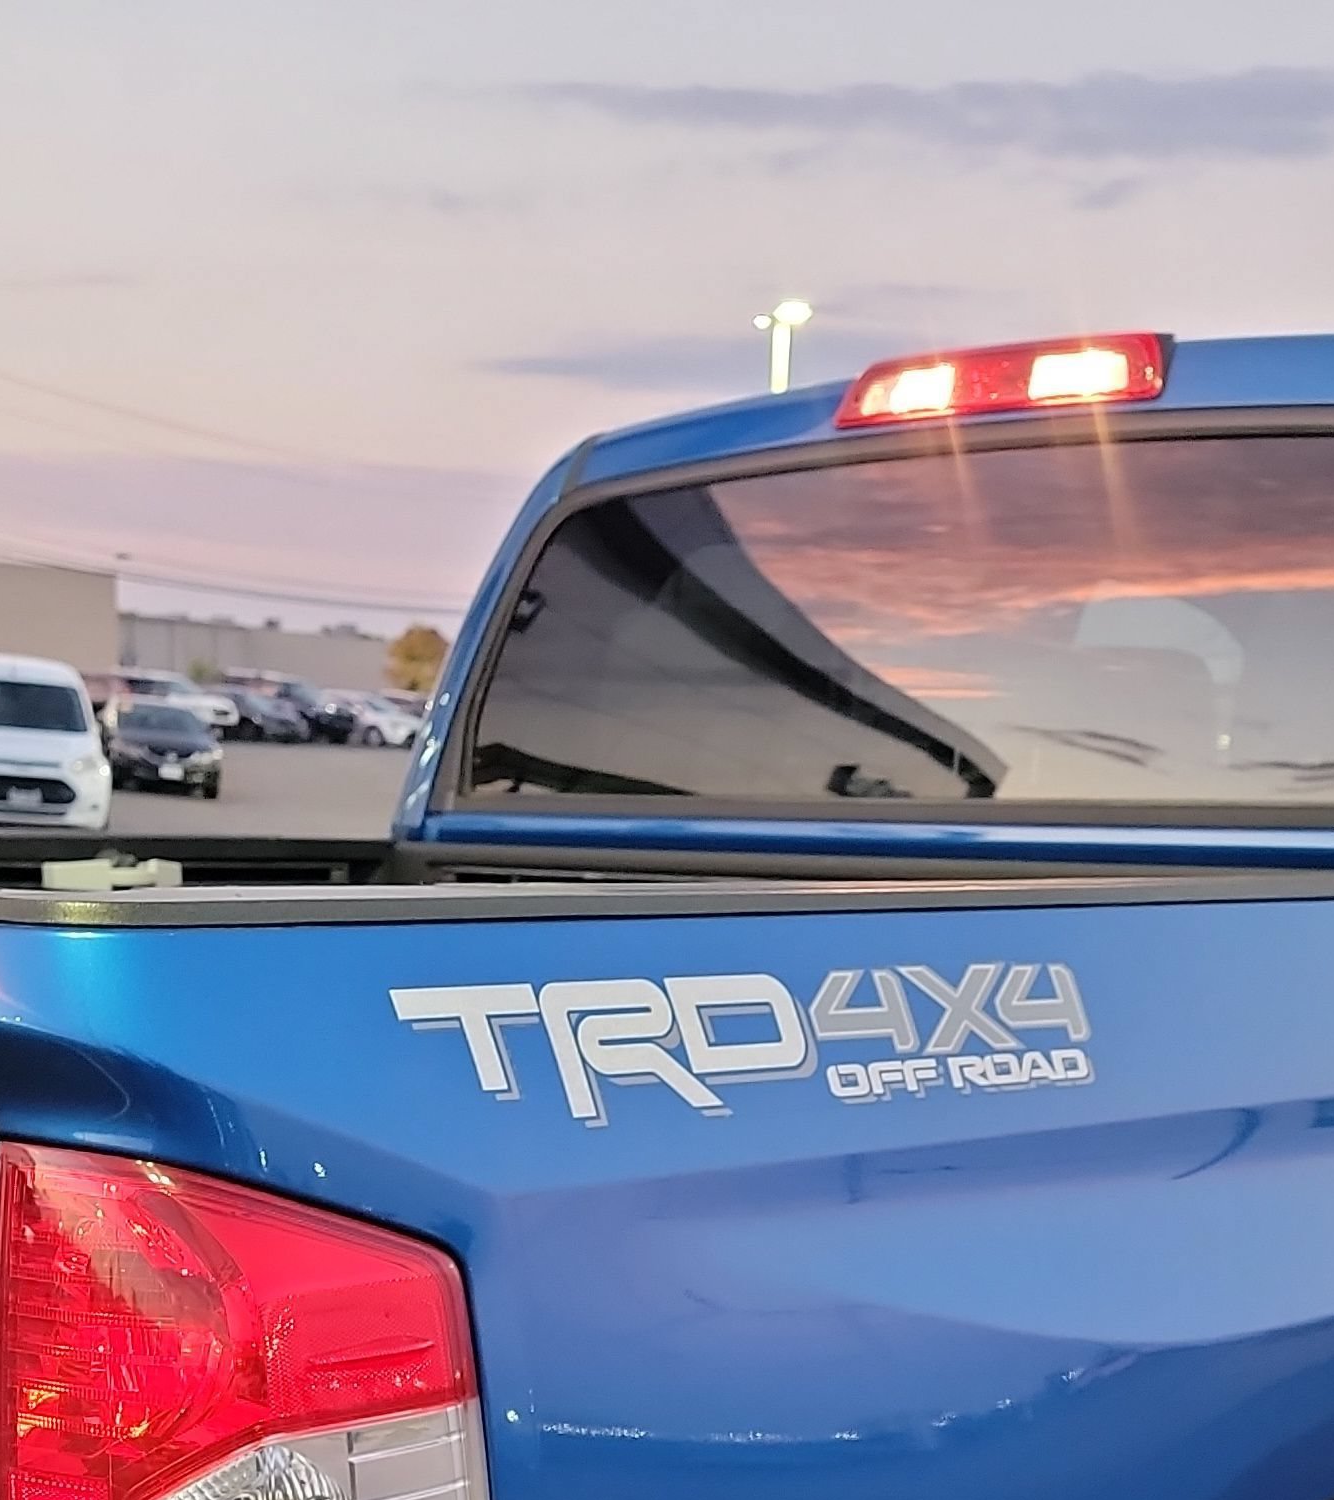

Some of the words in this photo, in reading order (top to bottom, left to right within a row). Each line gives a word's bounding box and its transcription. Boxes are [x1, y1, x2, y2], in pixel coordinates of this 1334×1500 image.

[388, 973, 816, 1127] TRD
[813, 962, 1091, 1053] 4X4
[827, 1059, 940, 1102] OFF
[946, 1049, 1094, 1093] ROAD
